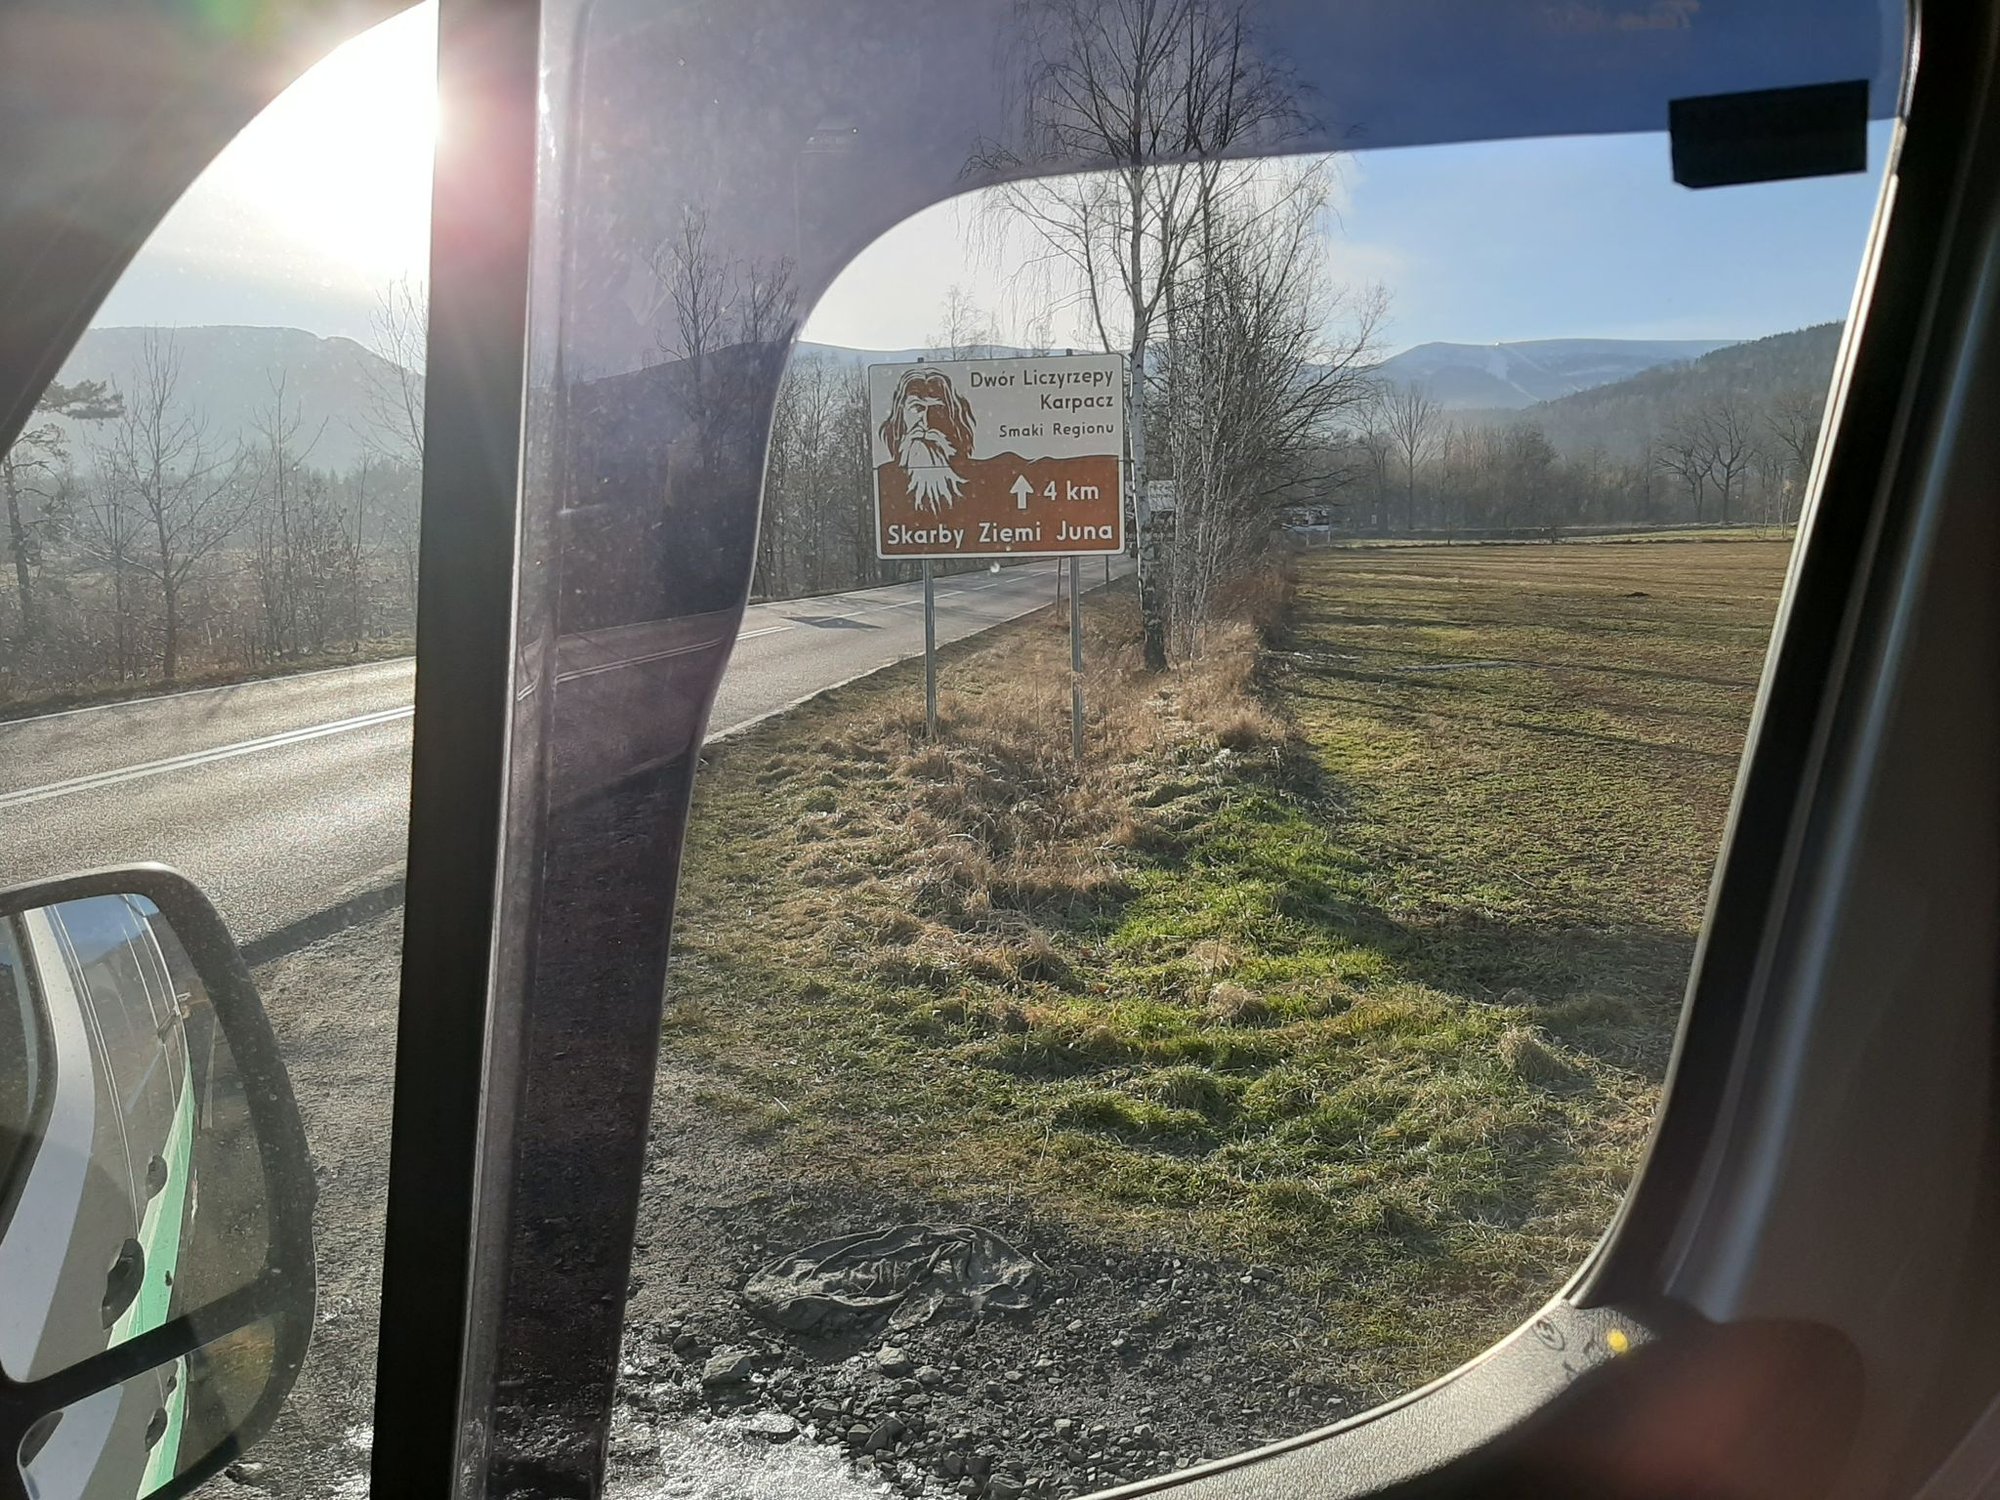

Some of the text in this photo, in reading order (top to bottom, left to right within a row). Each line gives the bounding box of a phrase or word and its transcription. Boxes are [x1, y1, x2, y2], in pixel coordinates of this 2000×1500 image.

[971, 369, 1114, 388] Dwór Liczyrzepy
[1041, 394, 1114, 413] Karpacz
[1000, 421, 1114, 439] Smaki Regionu
[1043, 480, 1099, 501] 4 km
[887, 520, 1113, 549] Skarby Ziemi Juna
